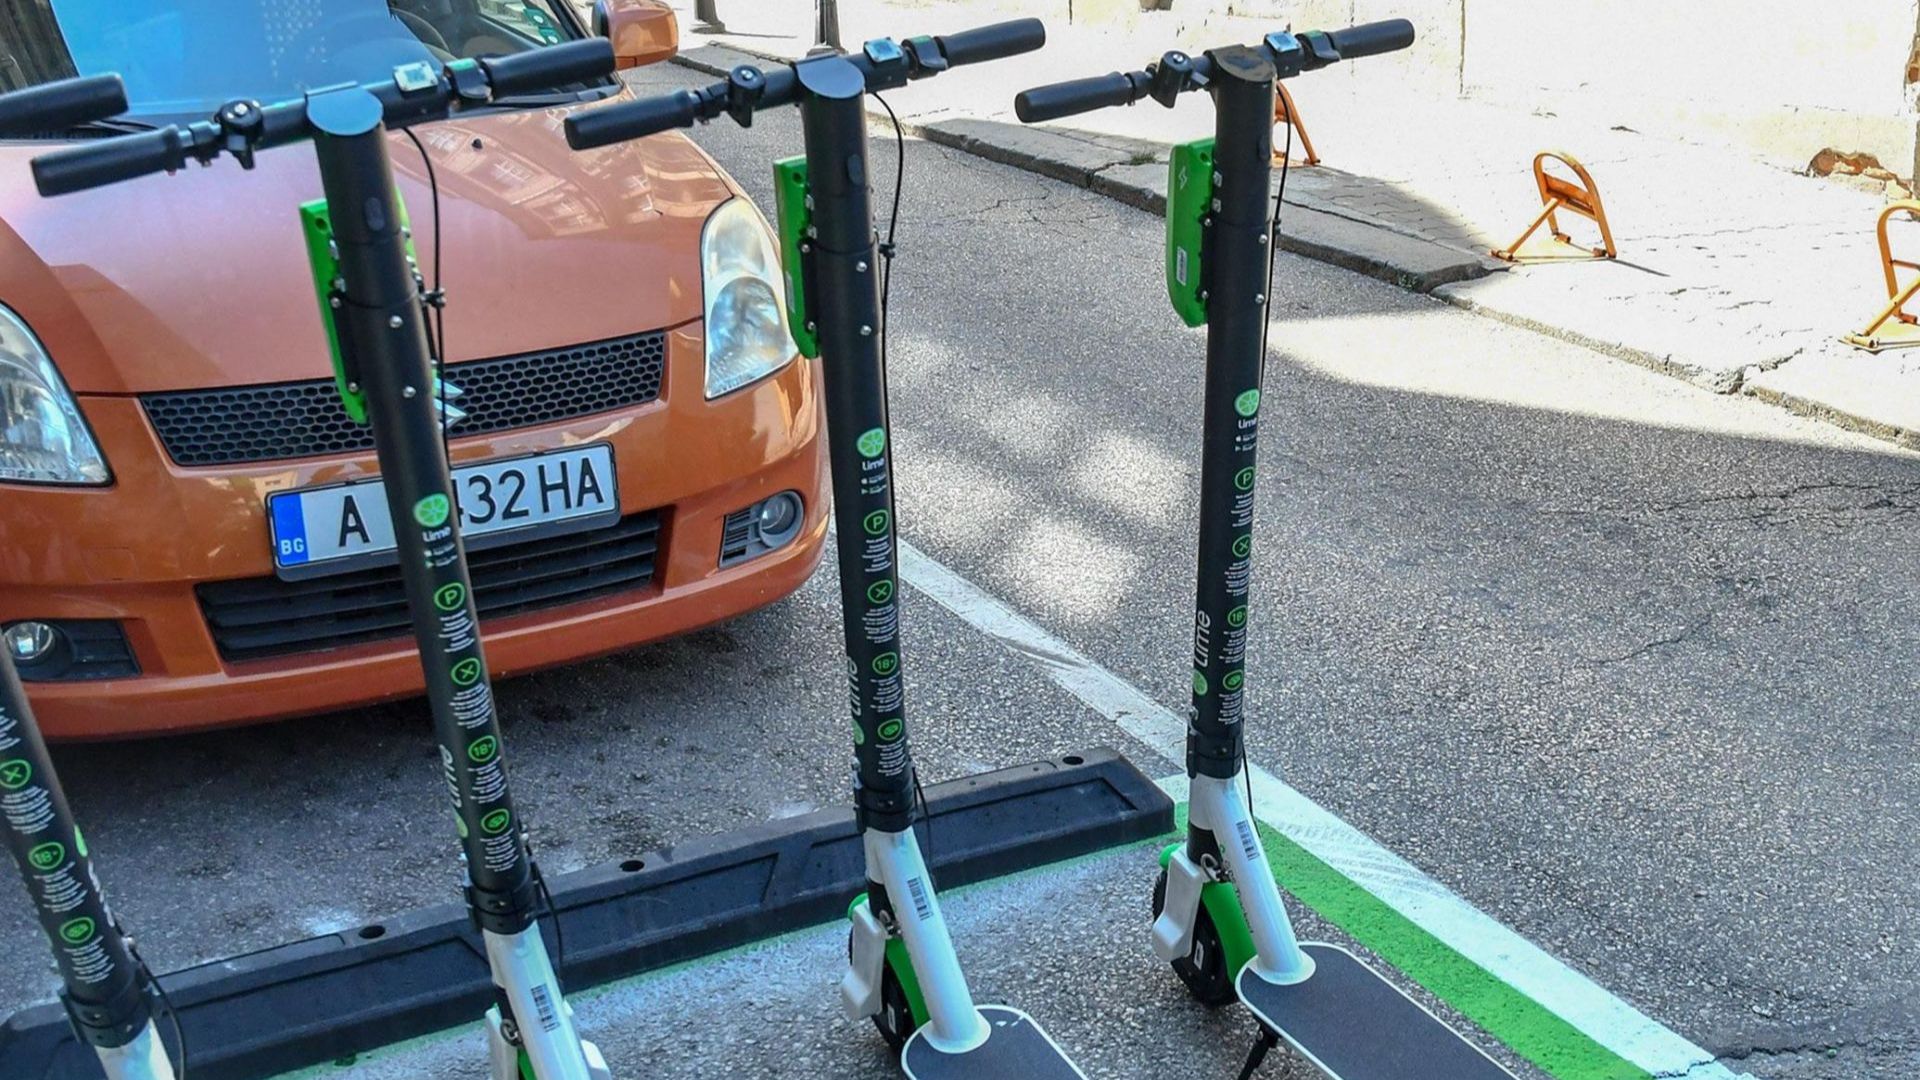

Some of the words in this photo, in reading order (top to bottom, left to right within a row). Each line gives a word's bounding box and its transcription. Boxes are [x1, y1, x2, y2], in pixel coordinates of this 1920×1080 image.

[338, 495, 371, 547] A
[538, 457, 605, 514] HA
[872, 516, 884, 529] P
[280, 538, 305, 555] BG
[444, 589, 458, 605] P
[1194, 609, 1211, 668] Lime
